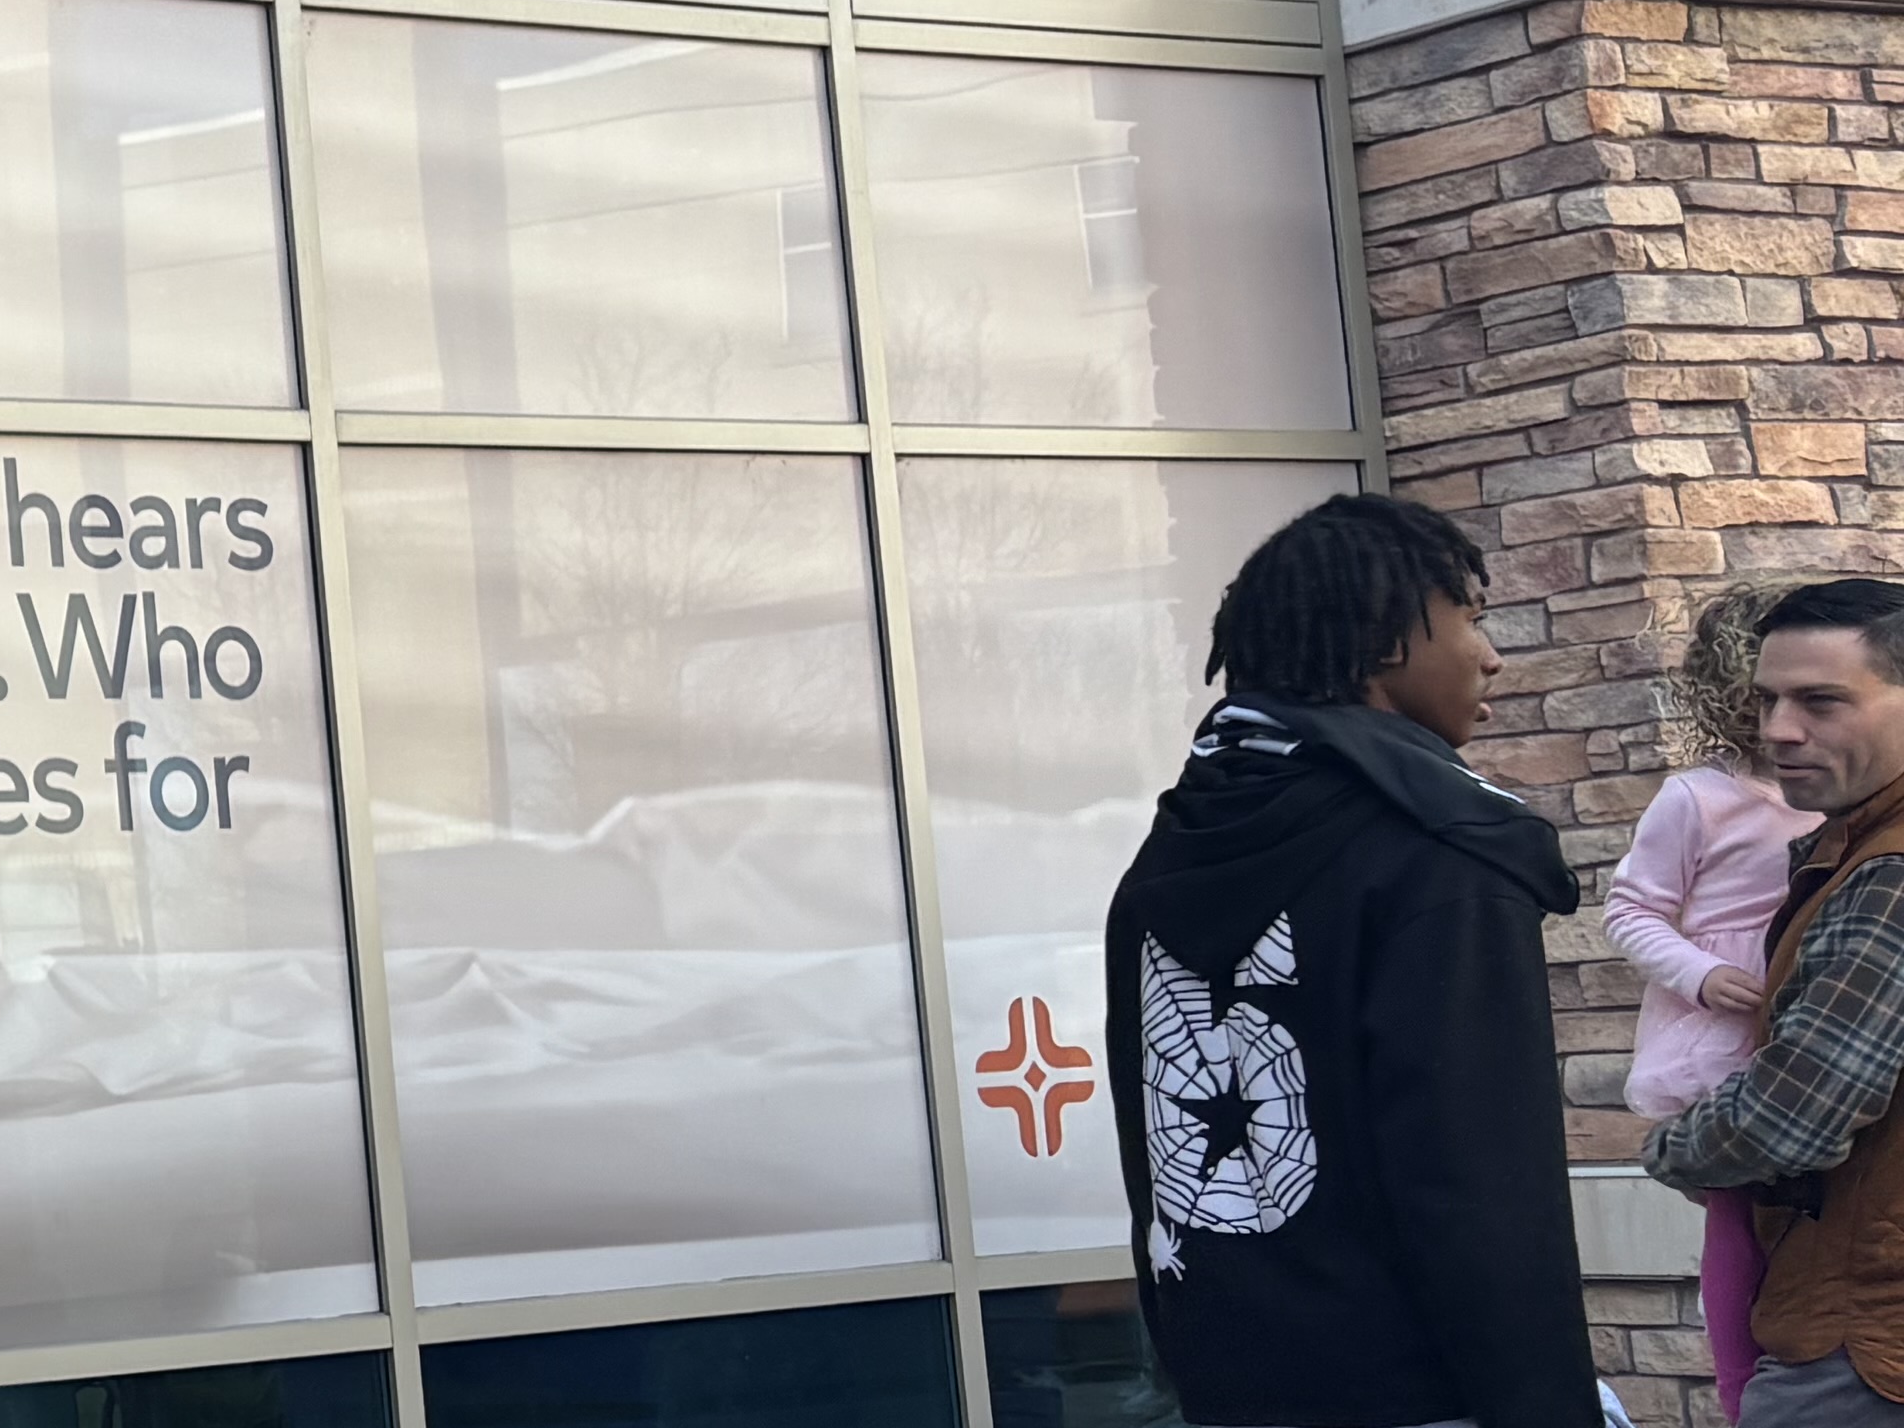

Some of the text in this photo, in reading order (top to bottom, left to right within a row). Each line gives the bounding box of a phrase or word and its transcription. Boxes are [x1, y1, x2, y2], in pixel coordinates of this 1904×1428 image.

[2, 456, 274, 570] hears
[15, 590, 263, 701] Who
[104, 719, 250, 832] for
